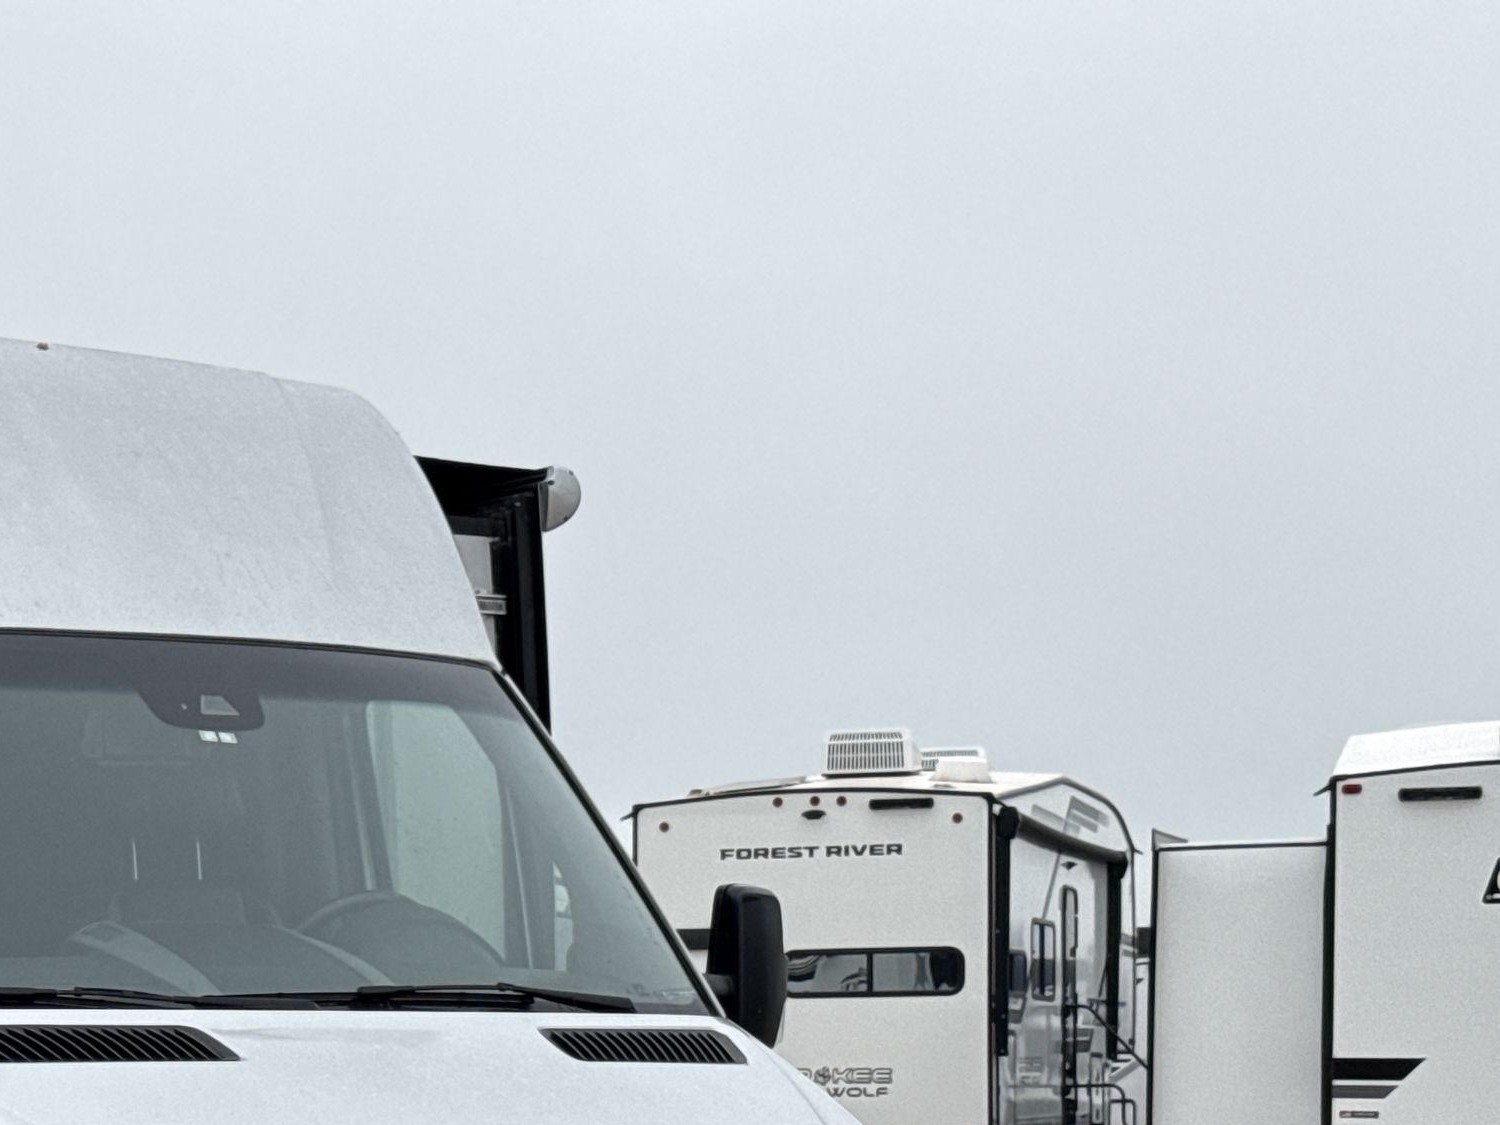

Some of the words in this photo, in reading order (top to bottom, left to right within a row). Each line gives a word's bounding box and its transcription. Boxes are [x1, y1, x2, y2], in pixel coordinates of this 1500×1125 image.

[719, 846, 819, 860] FOREST
[825, 843, 903, 857] RIVER
[826, 1087, 889, 1098] WOLF
